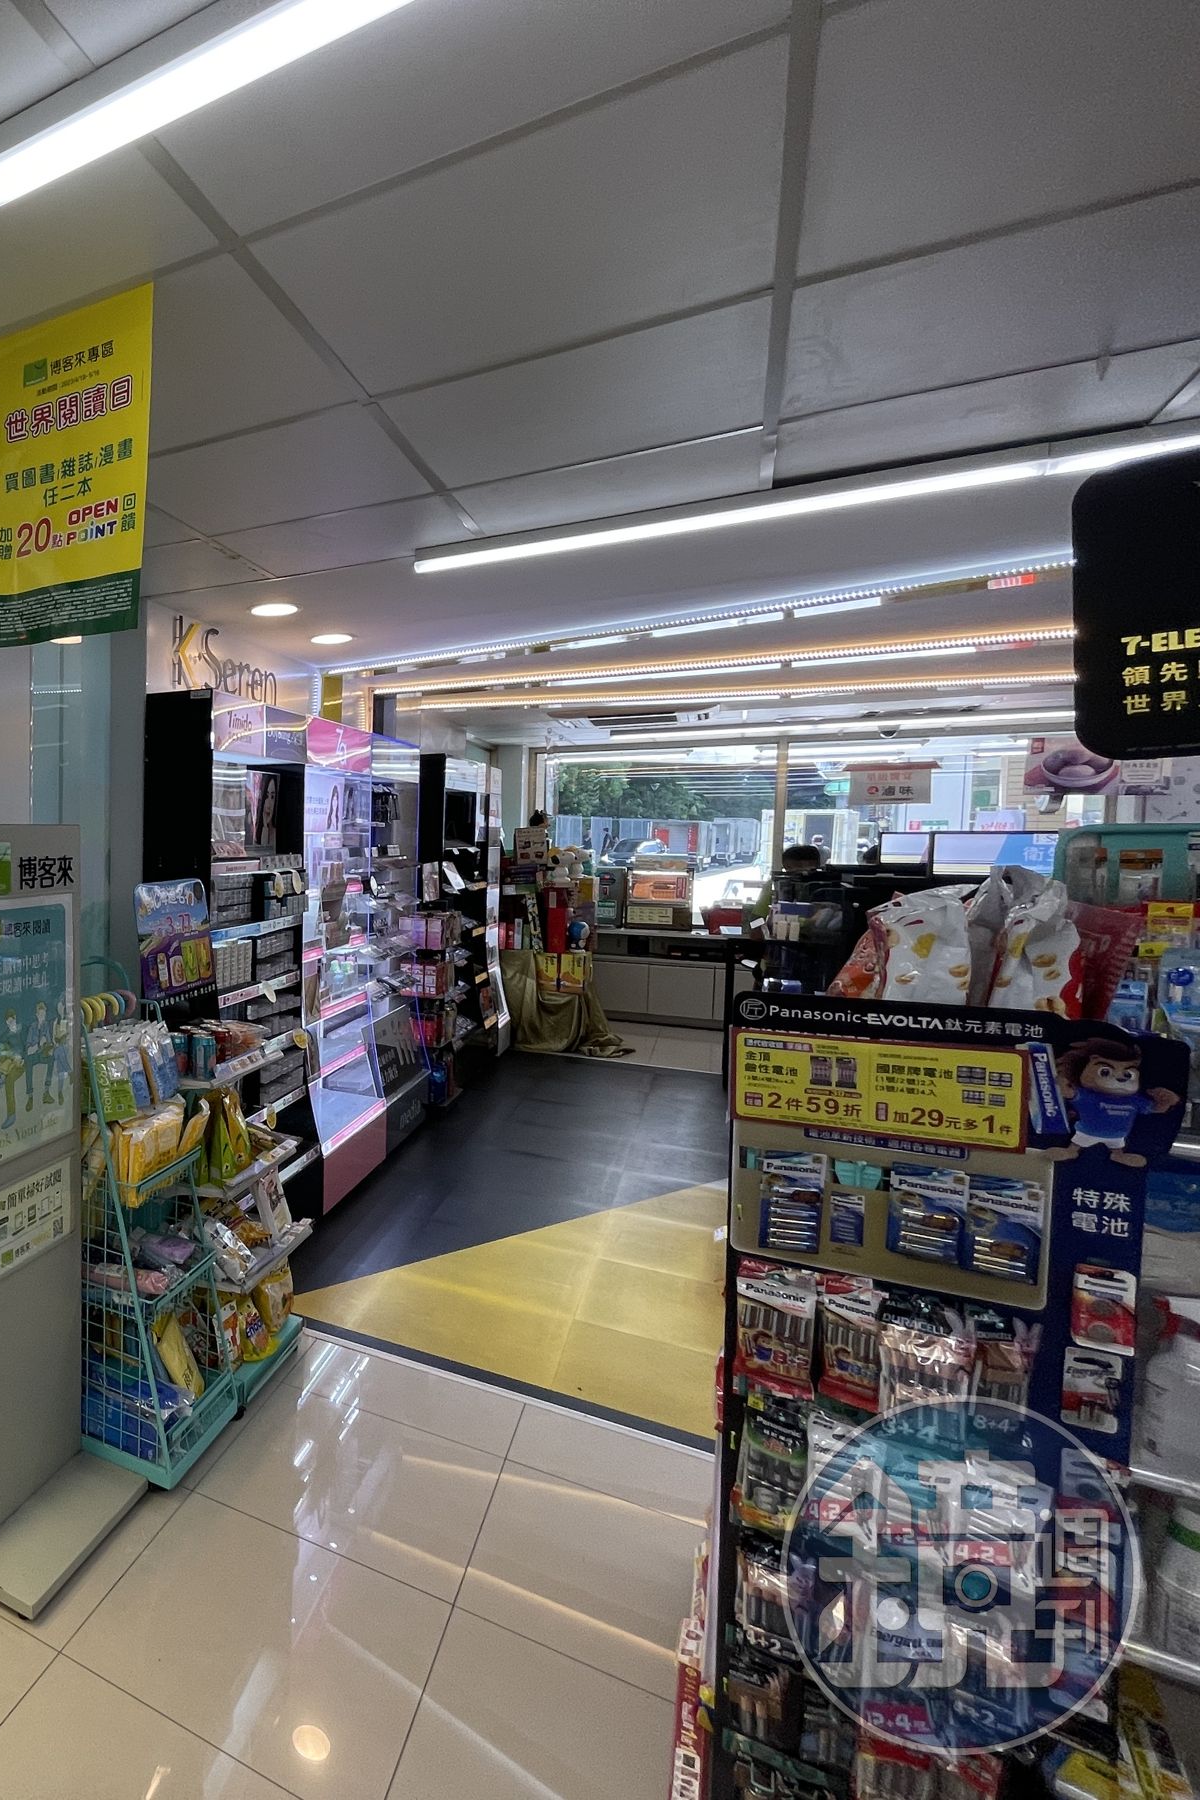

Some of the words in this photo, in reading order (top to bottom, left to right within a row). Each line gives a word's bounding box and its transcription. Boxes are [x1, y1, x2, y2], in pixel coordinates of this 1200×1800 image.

[50, 340, 113, 376] 博客來專區
[4, 374, 134, 443] 世界閱讀日
[5, 438, 133, 493] 買圖書/雜誌/漫畫
[43, 477, 93, 507] 任二本
[68, 498, 119, 526] OPEN
[1122, 660, 1200, 687] 領先
[1122, 690, 1200, 715] 世界
[18, 855, 74, 890] 博客來
[944, 1018, 1044, 1039] 鈦元素電池
[745, 1050, 771, 1062] 金頂
[744, 1062, 798, 1077] 鹼性電池
[1033, 1052, 1060, 1118] Panasonic
[767, 1091, 862, 1118] 2件59折
[15, 1126, 37, 1142] Your
[893, 1107, 1013, 1135] 加29元多1件
[766, 1162, 821, 1175] Panasonic
[898, 1177, 965, 1197] Panasonic
[1071, 1187, 1132, 1213] 特殊
[969, 1192, 1040, 1213] Panasonic
[1071, 1210, 1130, 1238] 電池
[745, 1282, 806, 1304] Panasonic
[828, 1298, 877, 1318] Panason
[882, 1312, 944, 1335] DURACELL
